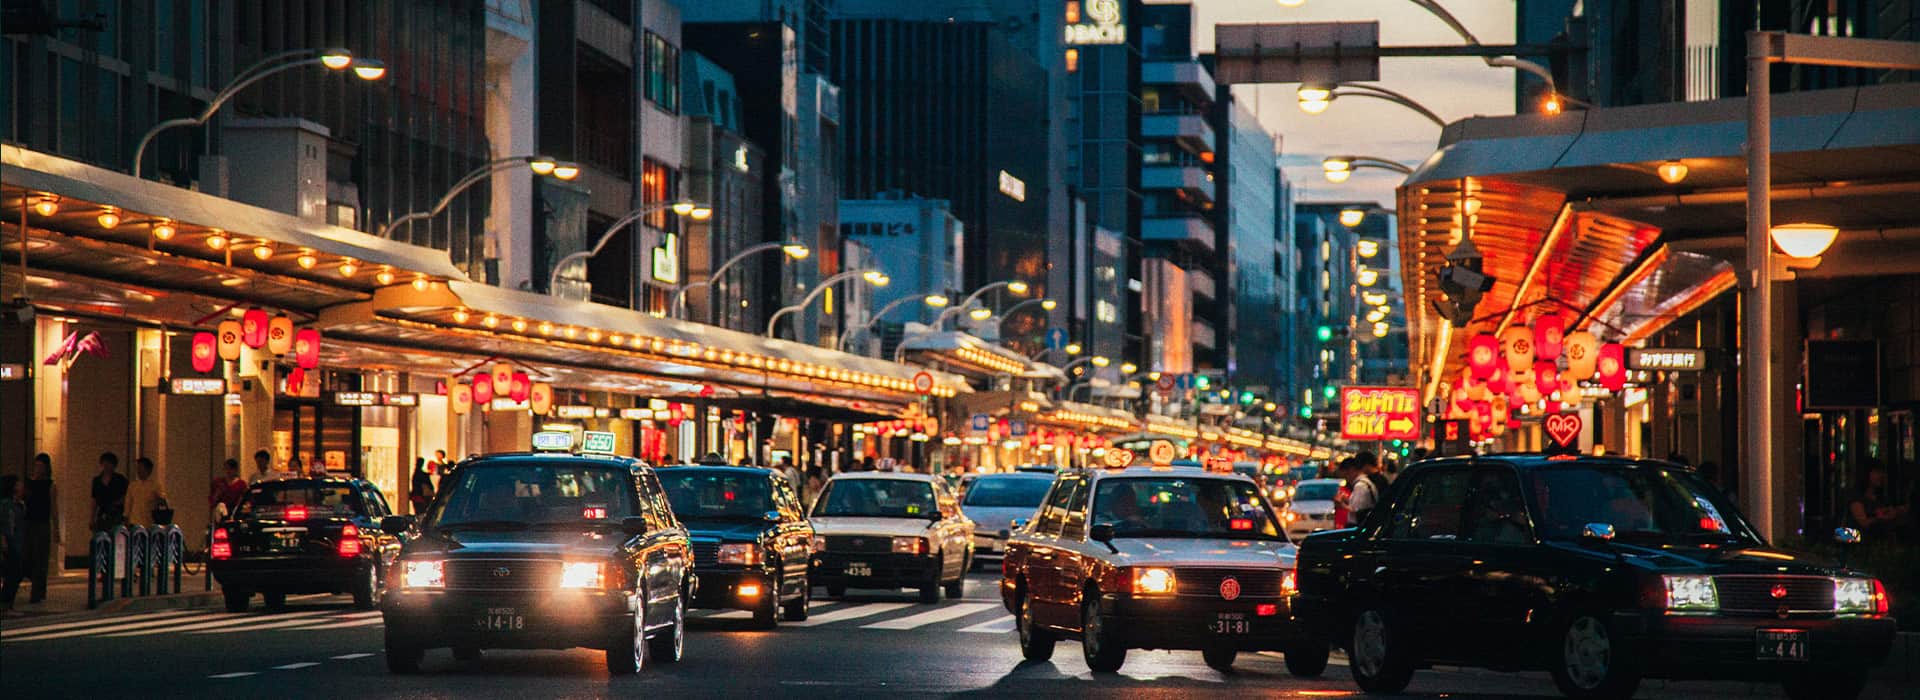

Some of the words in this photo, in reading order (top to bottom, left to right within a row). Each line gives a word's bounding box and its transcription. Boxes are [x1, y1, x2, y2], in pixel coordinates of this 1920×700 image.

[1551, 421, 1574, 432] MK
[487, 615, 523, 630] 14-18
[1216, 620, 1249, 633] 31-81
